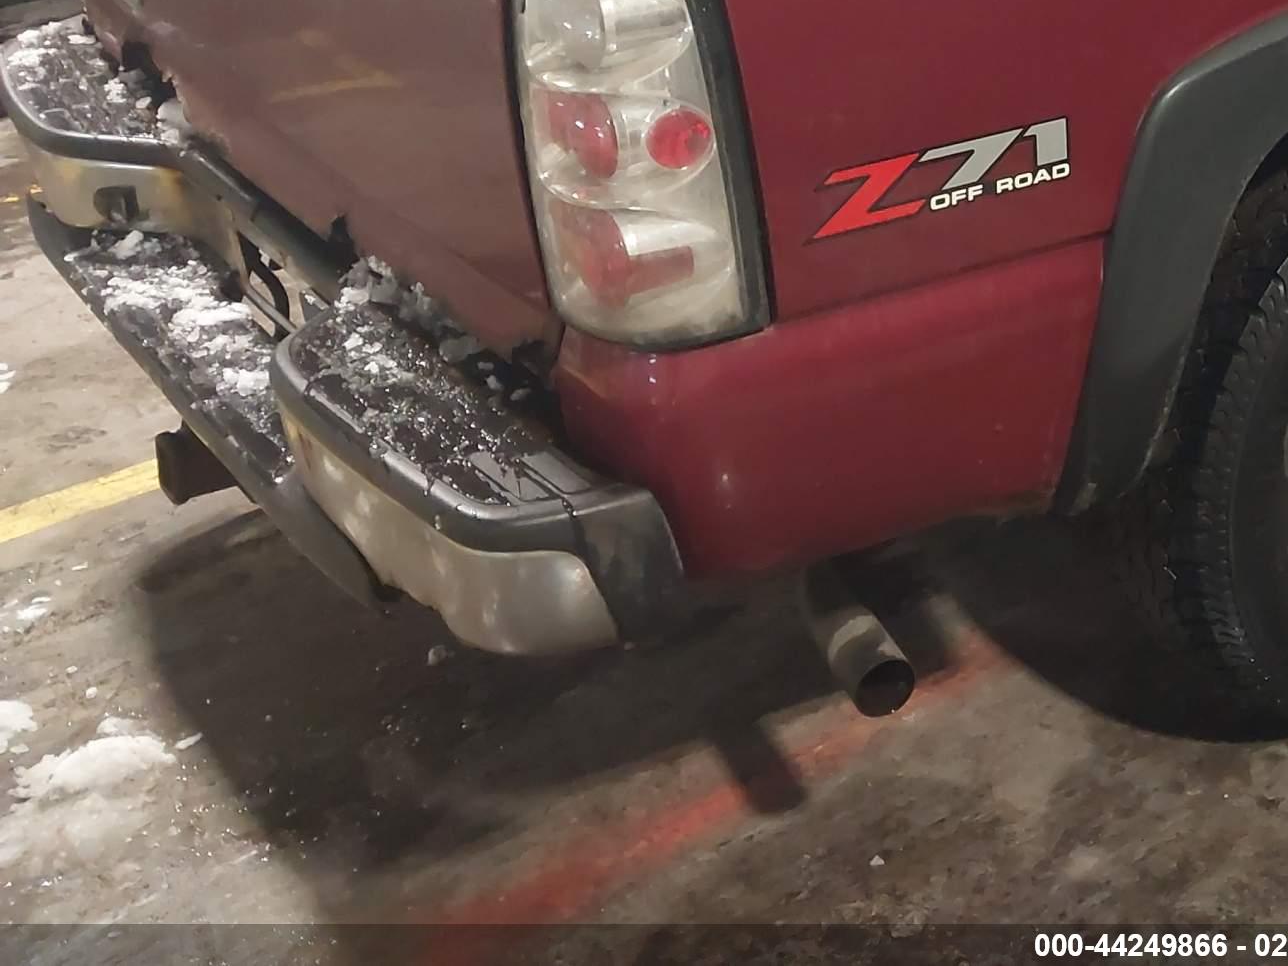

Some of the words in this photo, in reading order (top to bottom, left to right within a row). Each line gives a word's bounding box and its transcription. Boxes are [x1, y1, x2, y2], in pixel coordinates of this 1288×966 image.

[813, 117, 1068, 239] Z71
[930, 184, 983, 211] OFF
[996, 163, 1071, 194] ROAD
